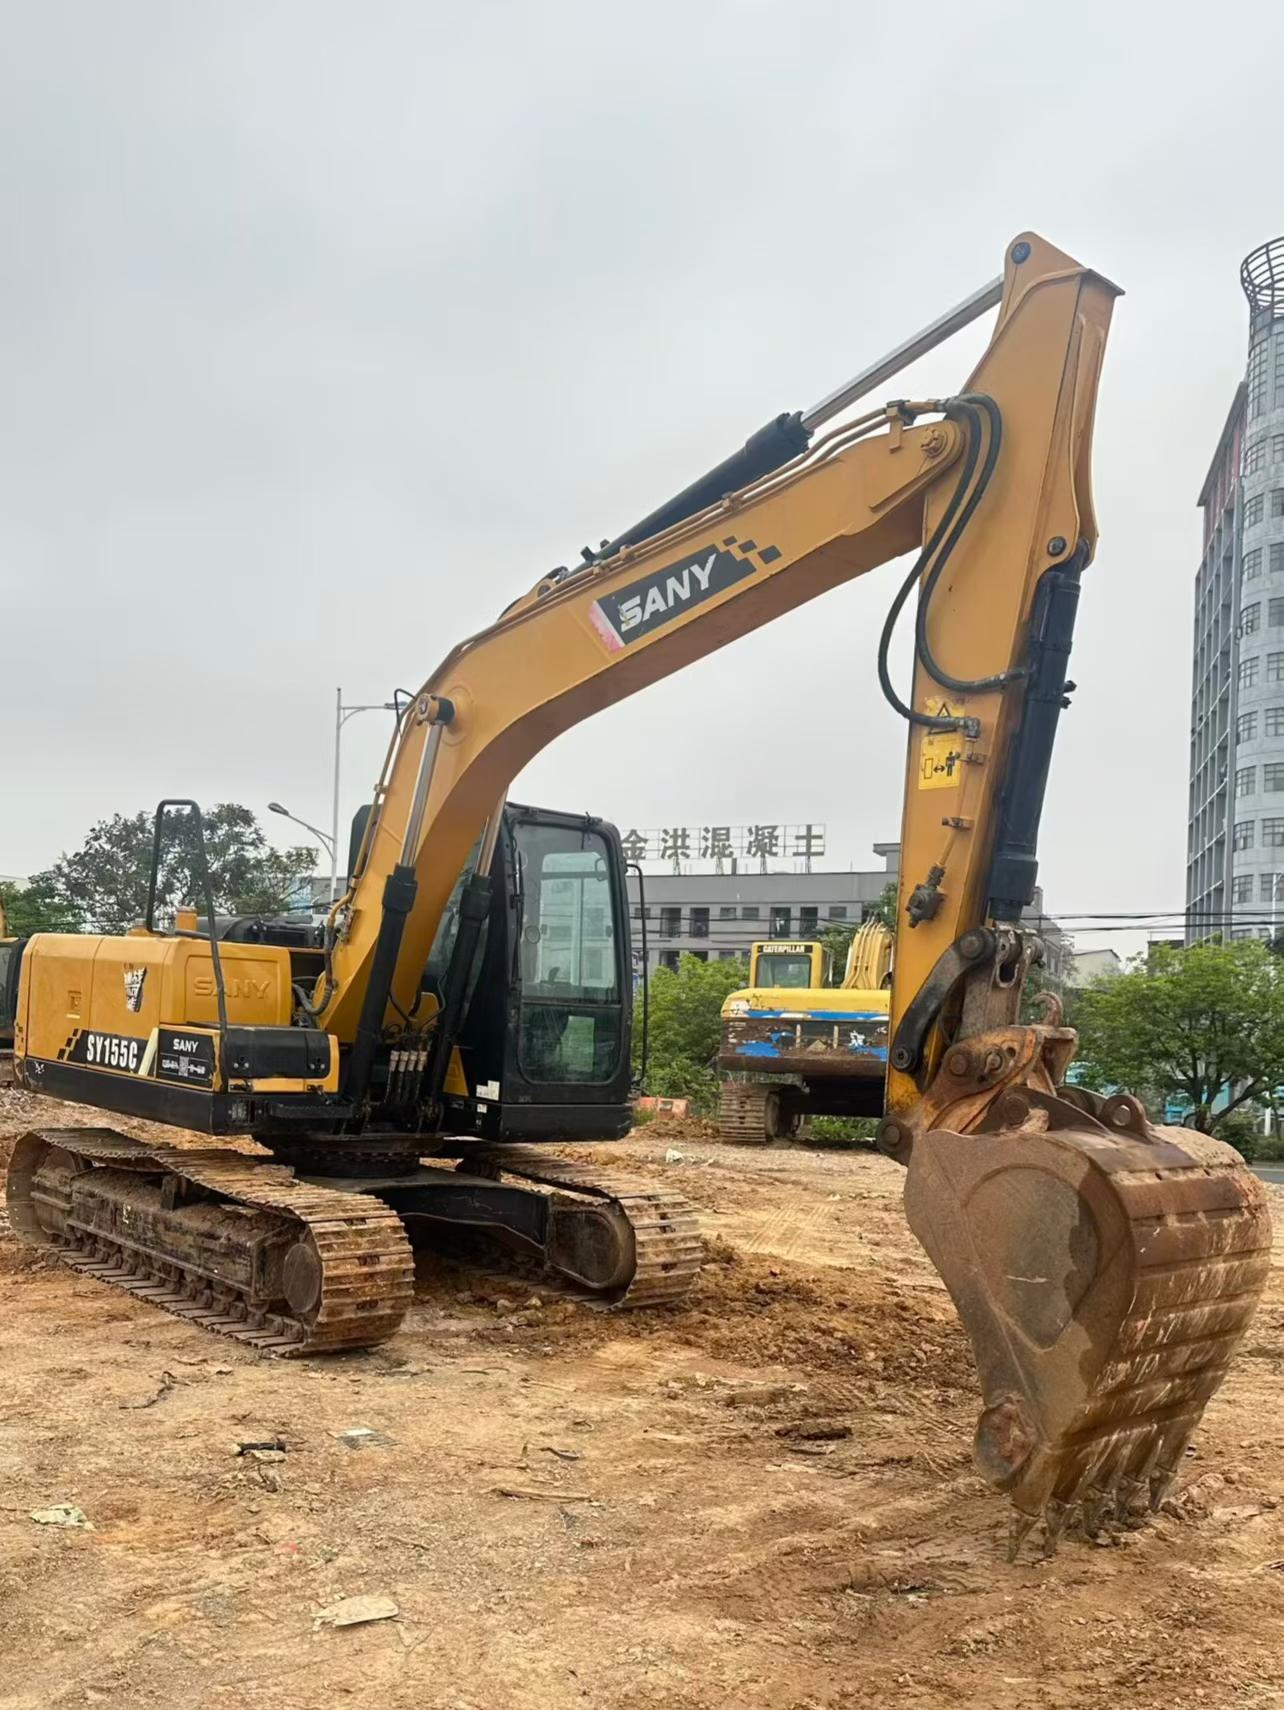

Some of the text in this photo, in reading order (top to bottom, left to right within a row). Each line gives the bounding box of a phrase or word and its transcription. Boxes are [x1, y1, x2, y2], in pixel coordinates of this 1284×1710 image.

[618, 553, 717, 632] SANY
[622, 824, 825, 860] 金洪混凝土
[762, 944, 806, 953] CATERPILLAR
[86, 1034, 138, 1070] SY155C
[172, 1038, 199, 1053] SANY
